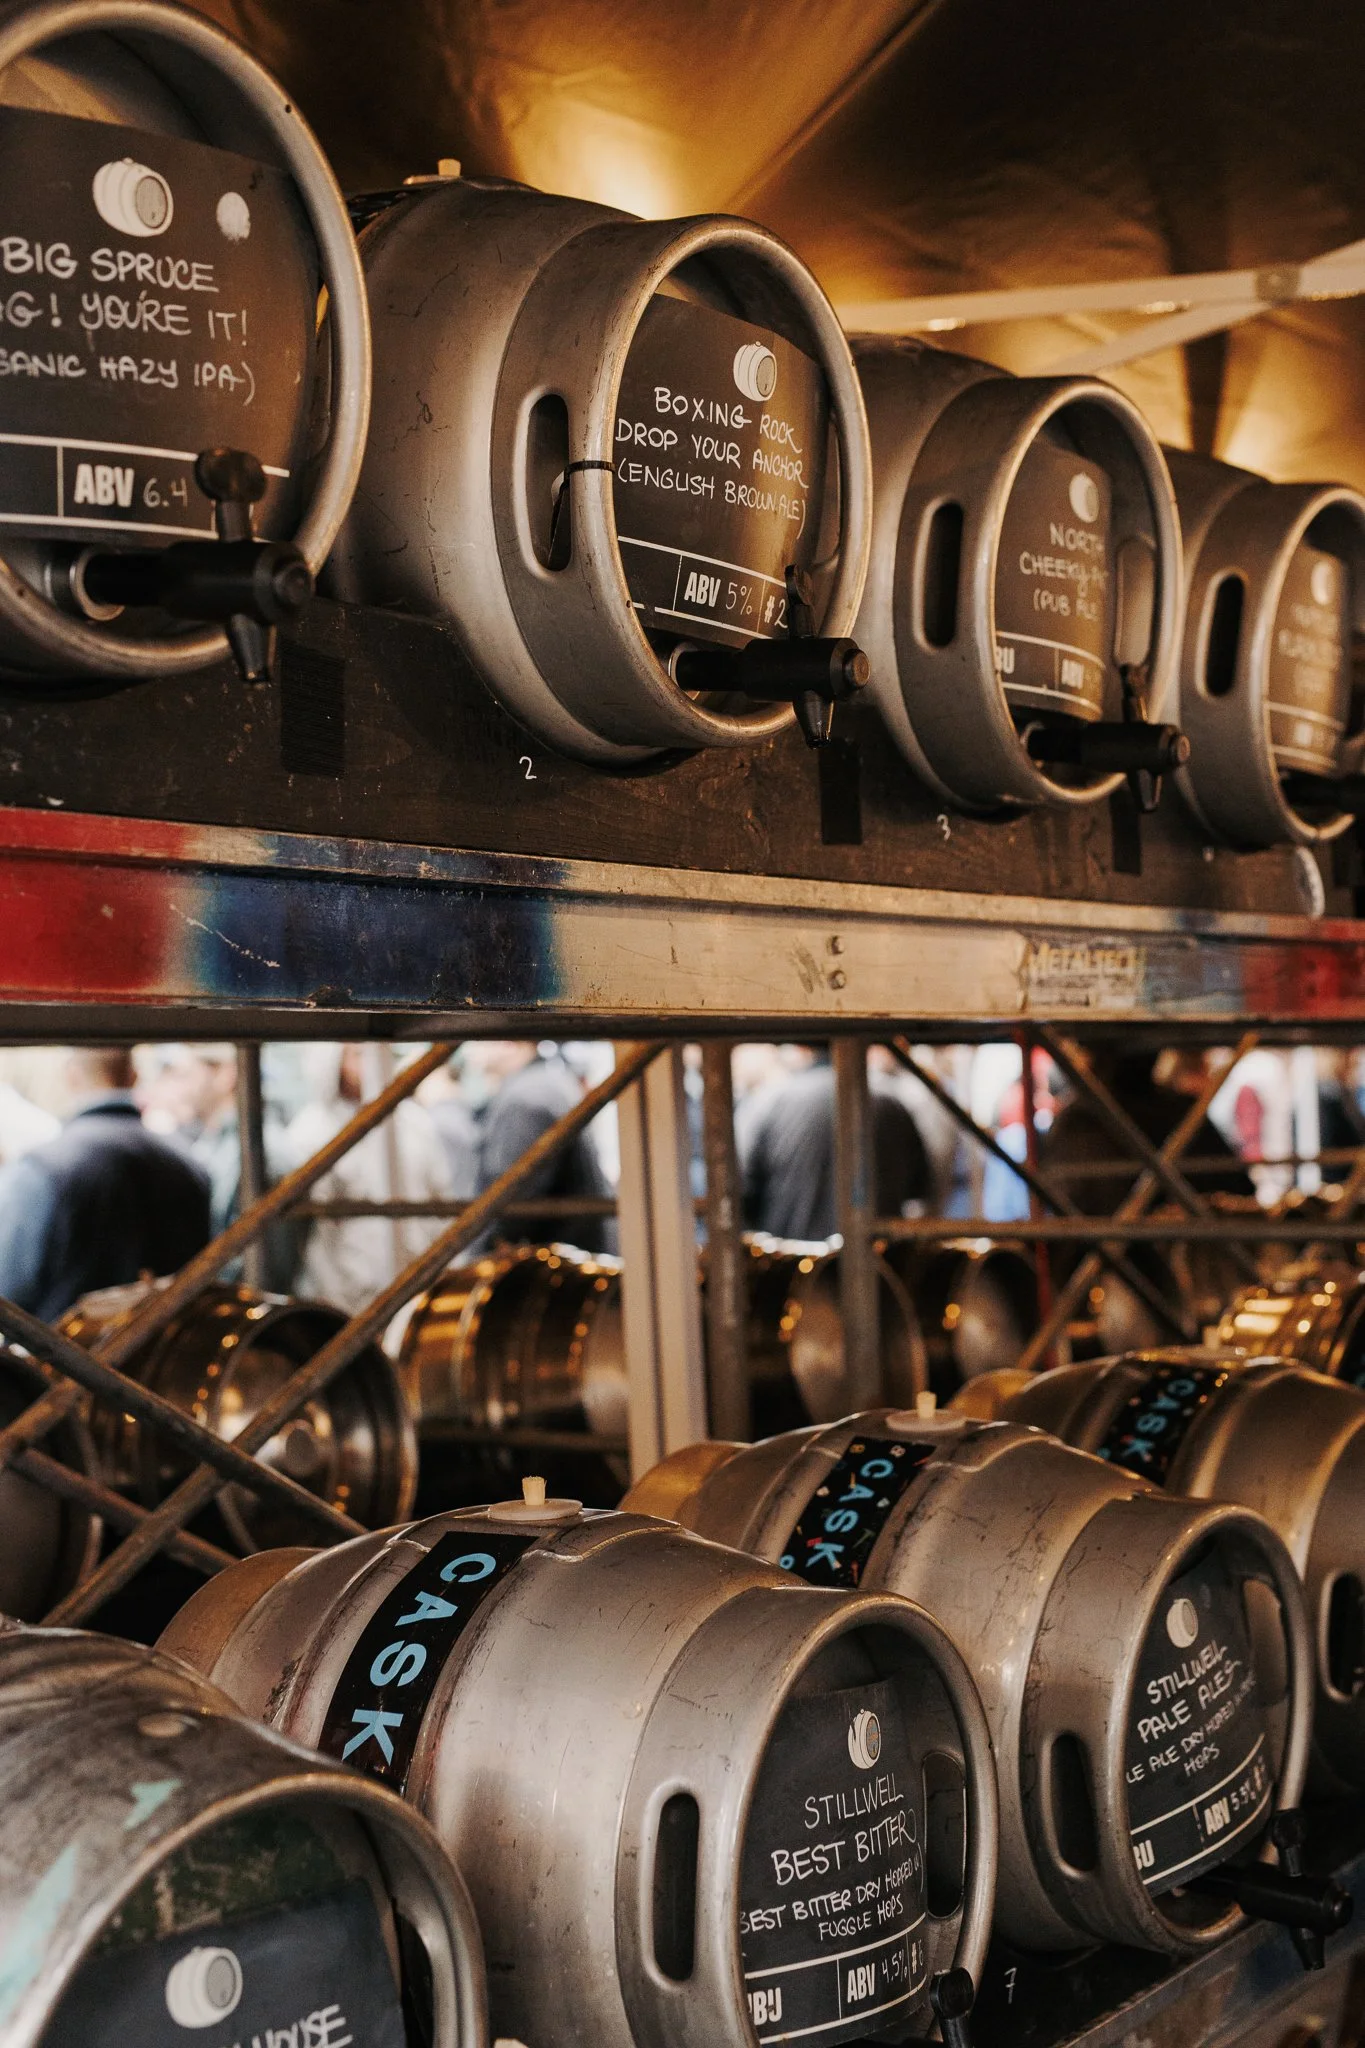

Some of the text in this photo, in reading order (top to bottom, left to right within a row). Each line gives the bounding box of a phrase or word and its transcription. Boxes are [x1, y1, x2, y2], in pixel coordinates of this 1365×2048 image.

[1, 237, 219, 293] BIG SPRUCE
[0, 290, 62, 328] G!
[208, 309, 247, 346] IT!
[100, 355, 178, 389] HAZY
[194, 361, 255, 406] IPA)
[654, 386, 803, 454] BOXING ROCK
[615, 418, 809, 489] DROP YOUR ANCHOR
[74, 463, 189, 509] ABV 6.4
[618, 458, 715, 500] (ENGLISH
[684, 571, 721, 608] ABV
[725, 582, 753, 615] 5%
[519, 756, 537, 780] 2
[805, 1458, 894, 1571] CASK
[341, 1552, 497, 1767] CASK
[1137, 1699, 1192, 1744] PALE
[1149, 1745, 1180, 1772] ALE
[804, 1773, 904, 1829] STILLWELL
[1203, 1797, 1231, 1836] ABV
[771, 1808, 917, 1886] BEST BITTER
[792, 1889, 851, 1921] BITTER
[856, 1876, 881, 1905] DRY
[818, 1893, 904, 1941] FUGGLE HOPS
[847, 1963, 876, 2004] ABV
